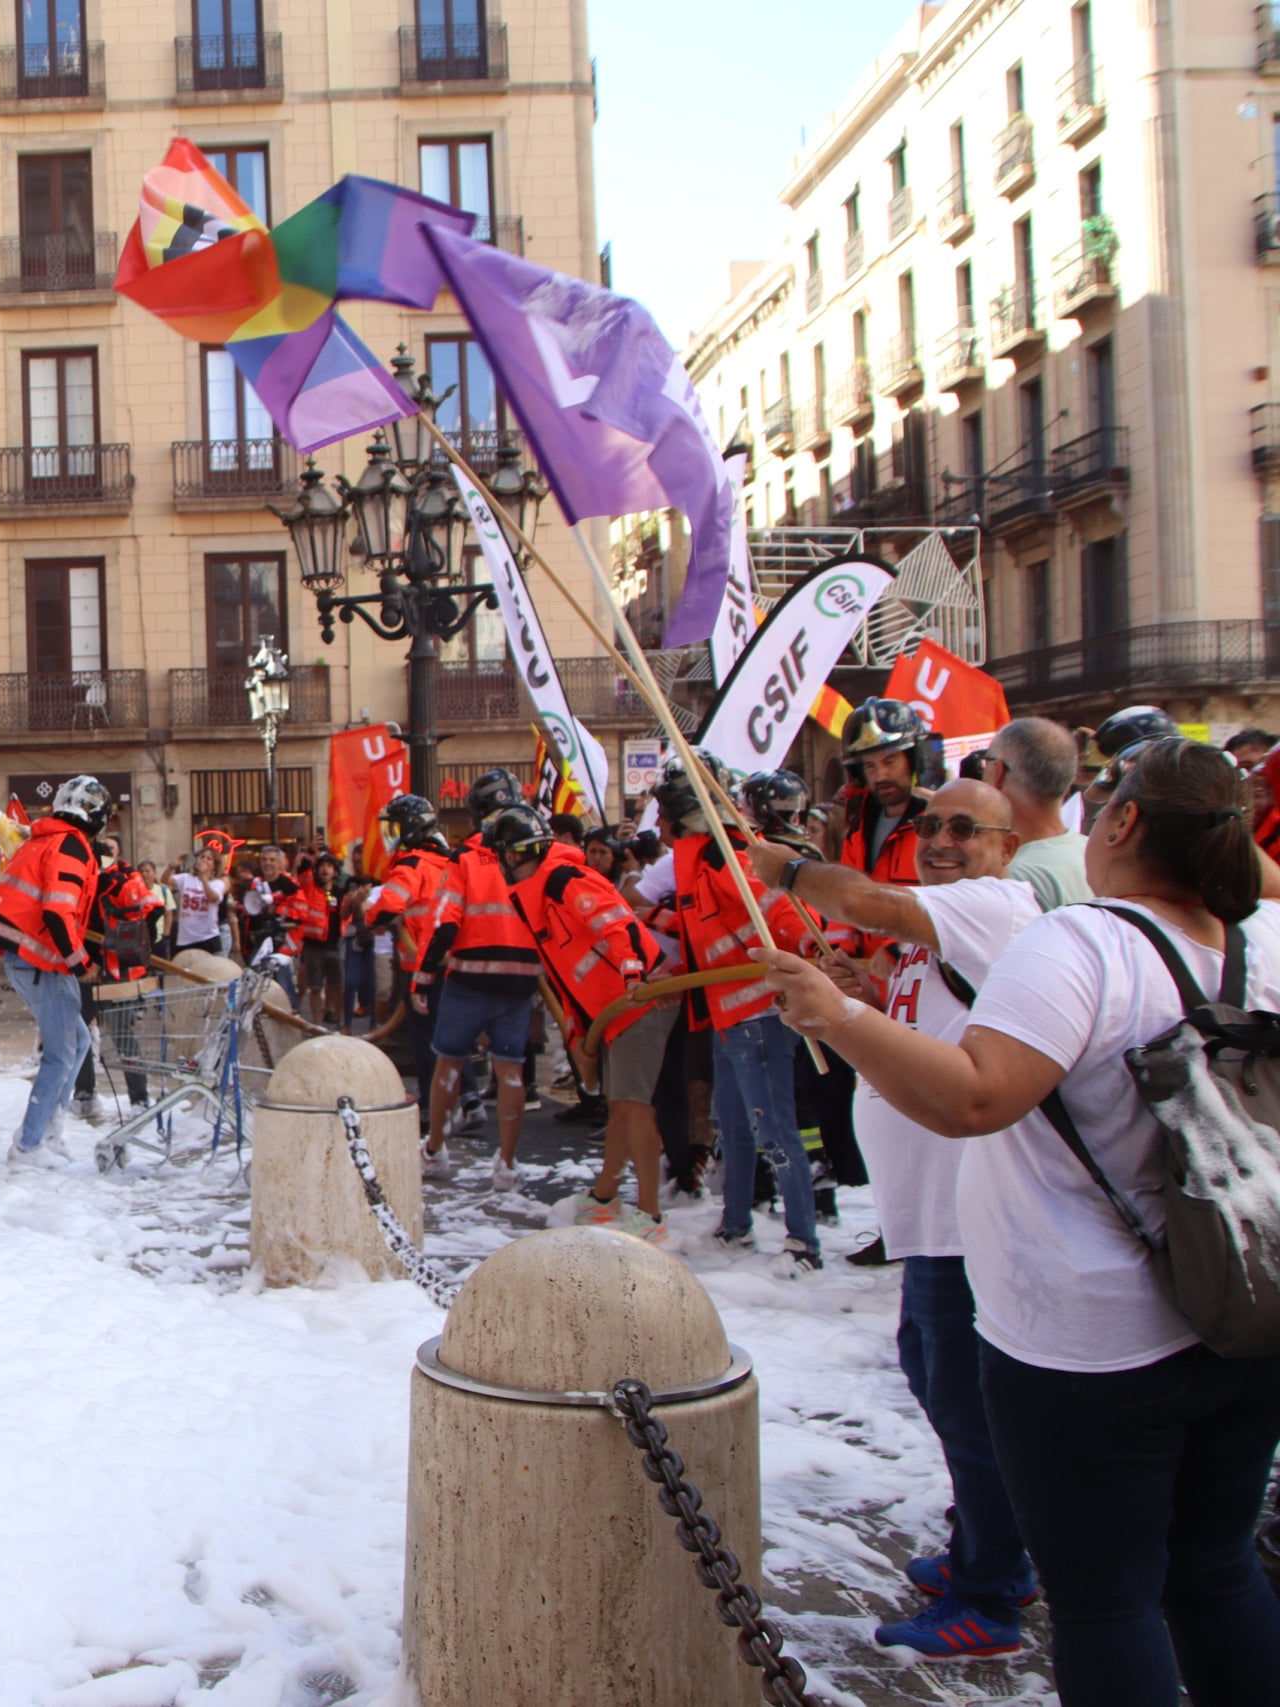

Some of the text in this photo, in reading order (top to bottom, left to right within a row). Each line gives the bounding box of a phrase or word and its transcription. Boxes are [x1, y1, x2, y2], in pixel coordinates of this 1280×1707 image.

[726, 564, 748, 660] SIF
[826, 584, 864, 615] CSIF
[747, 627, 810, 754] CSIF
